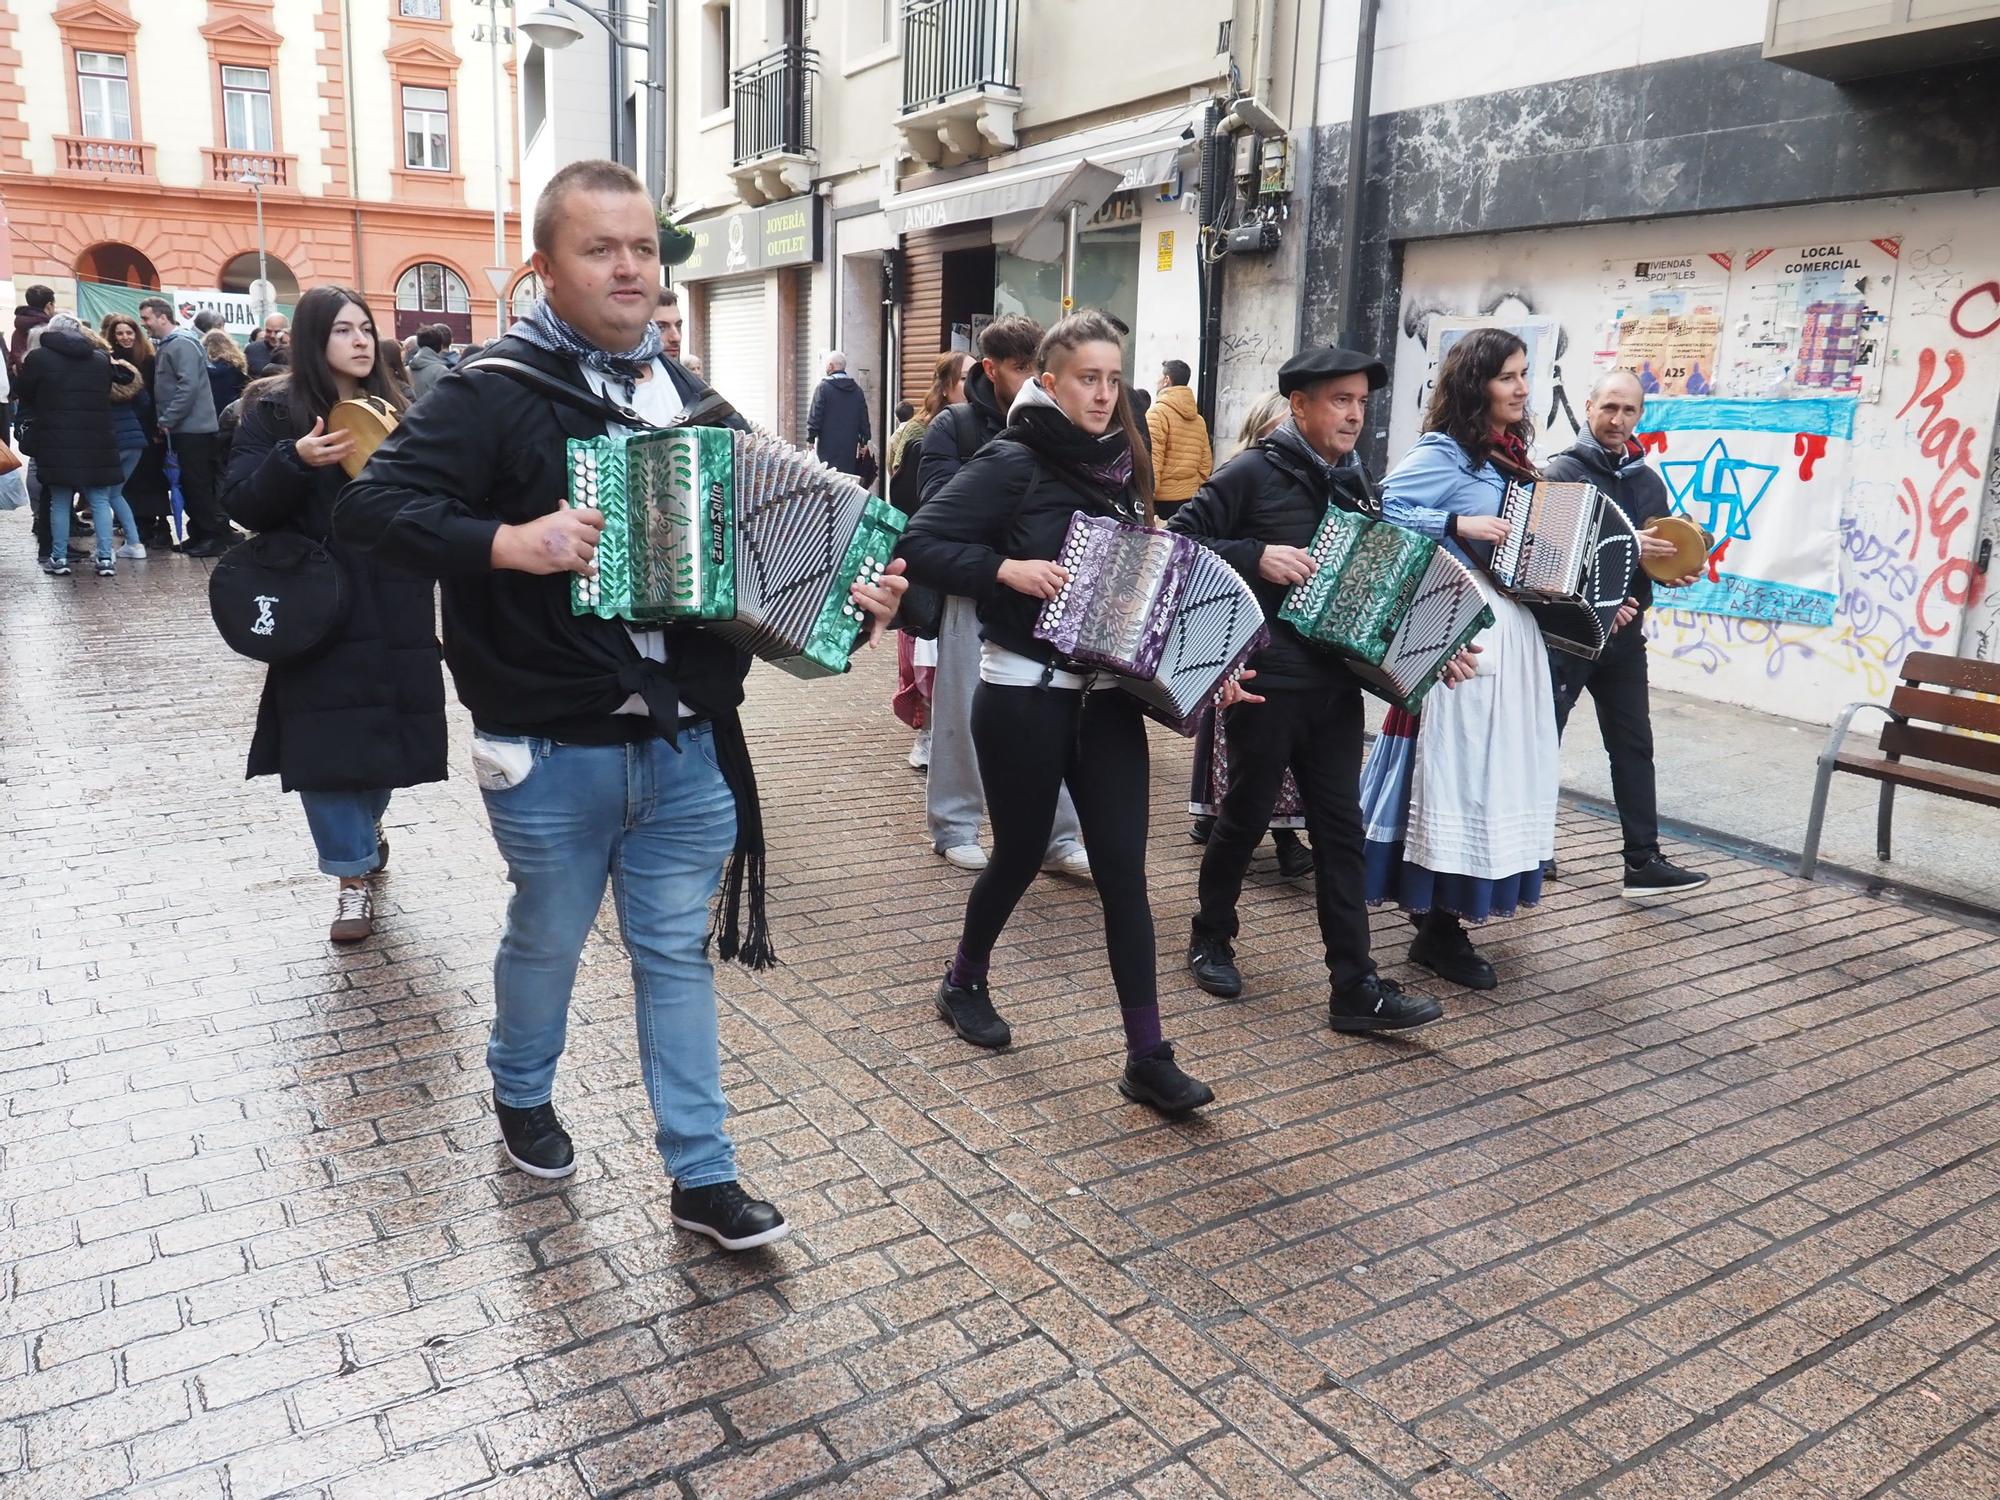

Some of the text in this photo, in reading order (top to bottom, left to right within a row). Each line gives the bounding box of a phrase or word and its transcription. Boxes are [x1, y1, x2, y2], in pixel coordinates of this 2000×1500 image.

[904, 202, 948, 229] ANDIA
[767, 235, 806, 257] OUTLET
[1801, 246, 1844, 258] LOCAL
[1648, 258, 1692, 270] IVIENDAS
[1784, 258, 1862, 274] COMERCIAL
[1664, 367, 1686, 378] A25
